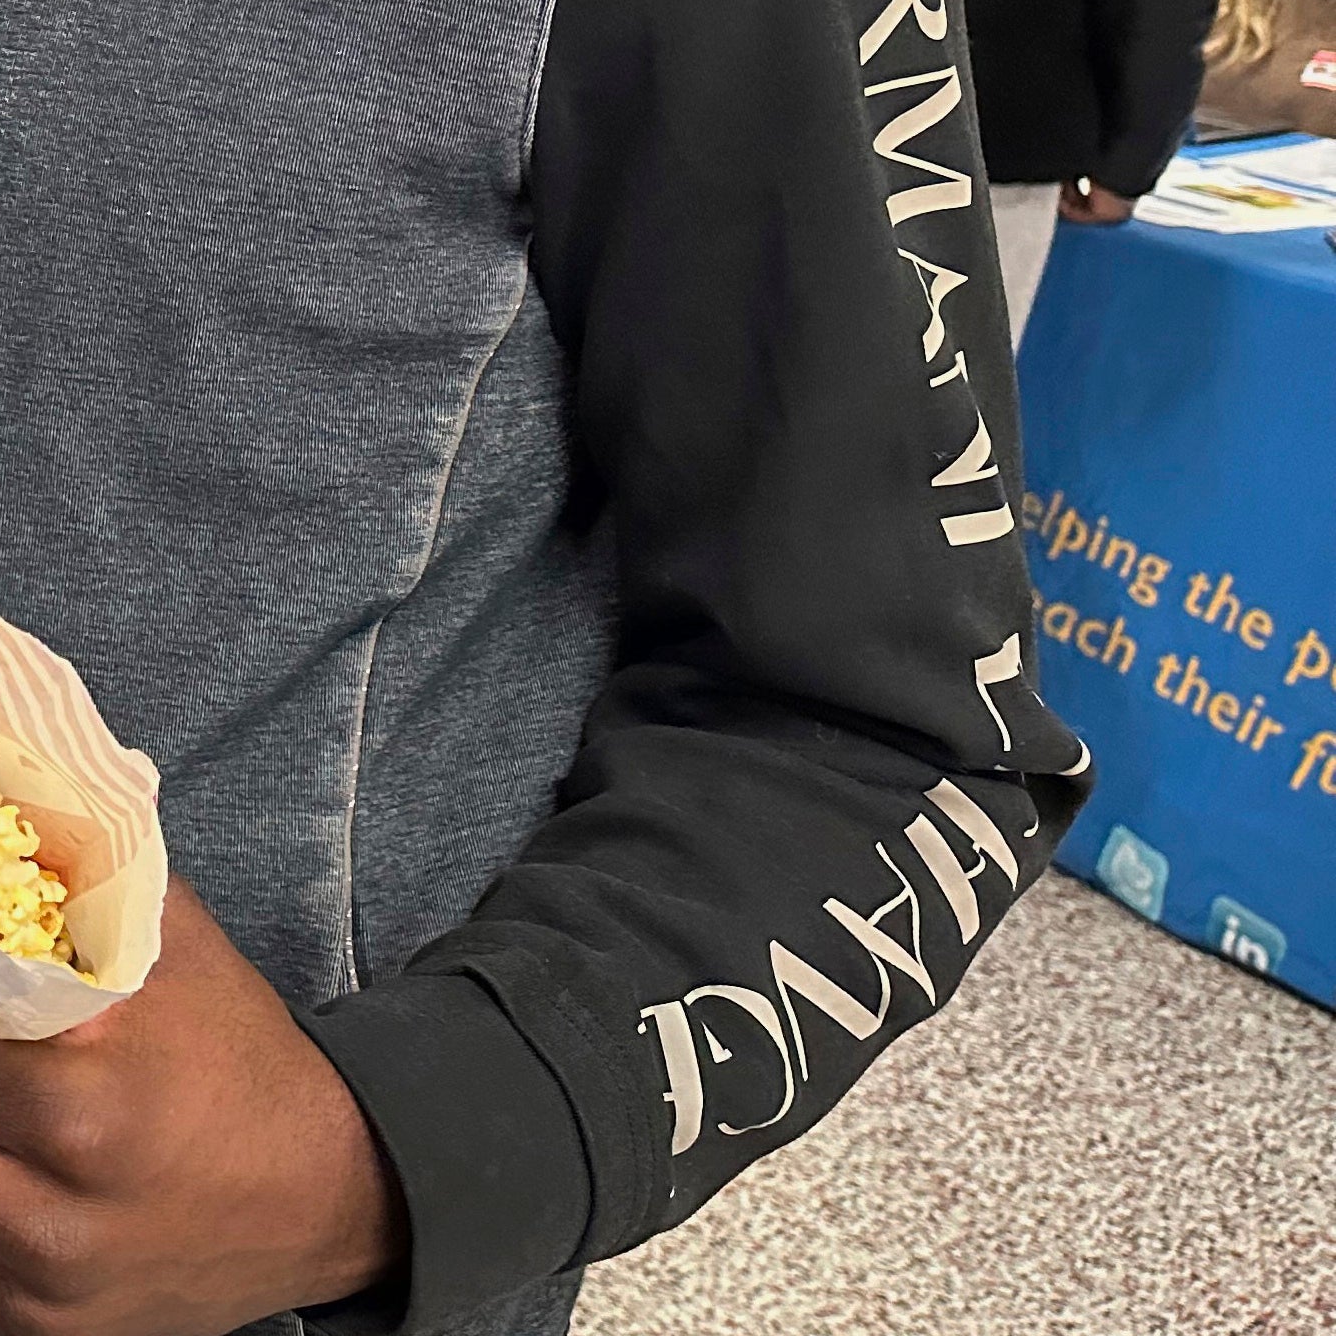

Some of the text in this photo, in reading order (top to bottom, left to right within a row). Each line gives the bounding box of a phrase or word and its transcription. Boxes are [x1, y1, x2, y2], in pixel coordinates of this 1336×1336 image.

[1022, 490, 1173, 608] elping
[1183, 571, 1275, 652] the
[1031, 589, 1138, 674] ach
[1153, 653, 1285, 752] their
